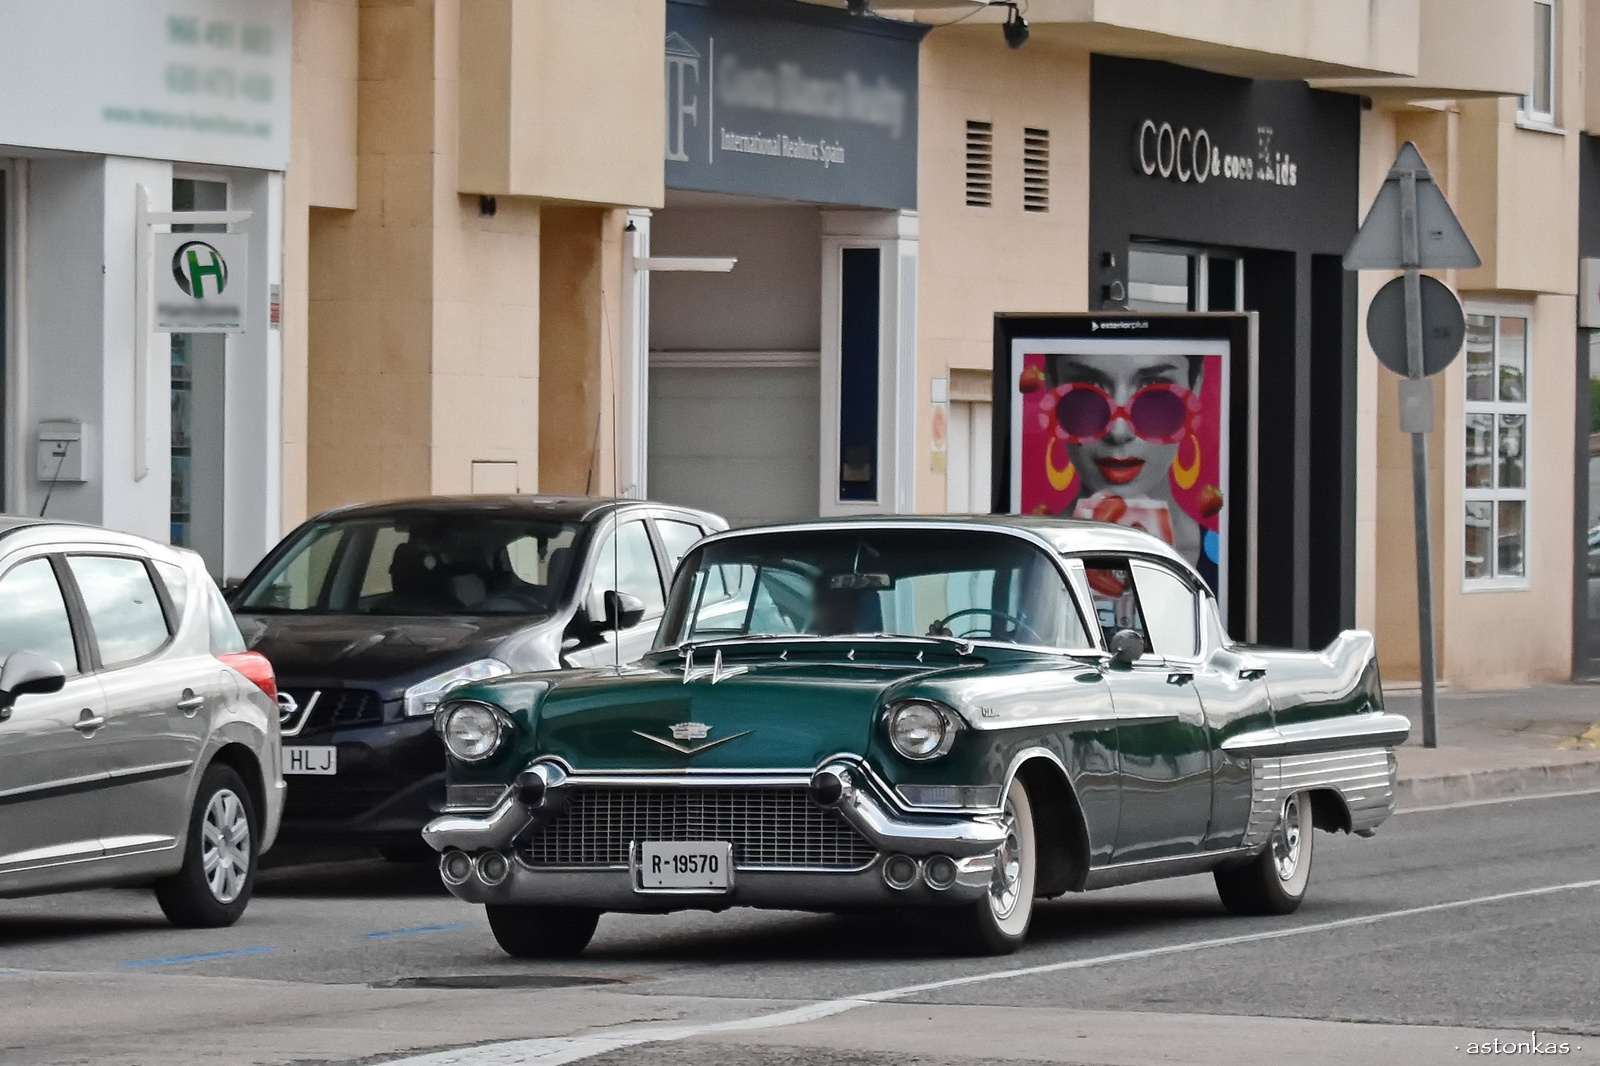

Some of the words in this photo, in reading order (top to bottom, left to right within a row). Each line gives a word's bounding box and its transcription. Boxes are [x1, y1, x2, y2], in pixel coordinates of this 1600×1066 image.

[721, 127, 780, 157] International
[782, 134, 818, 161] Realtors
[820, 139, 845, 169] Spain
[1139, 119, 1211, 184] COCO
[1224, 154, 1253, 181] coco
[187, 250, 225, 299] H
[291, 750, 331, 771] HLJ
[652, 854, 719, 874] R-19570
